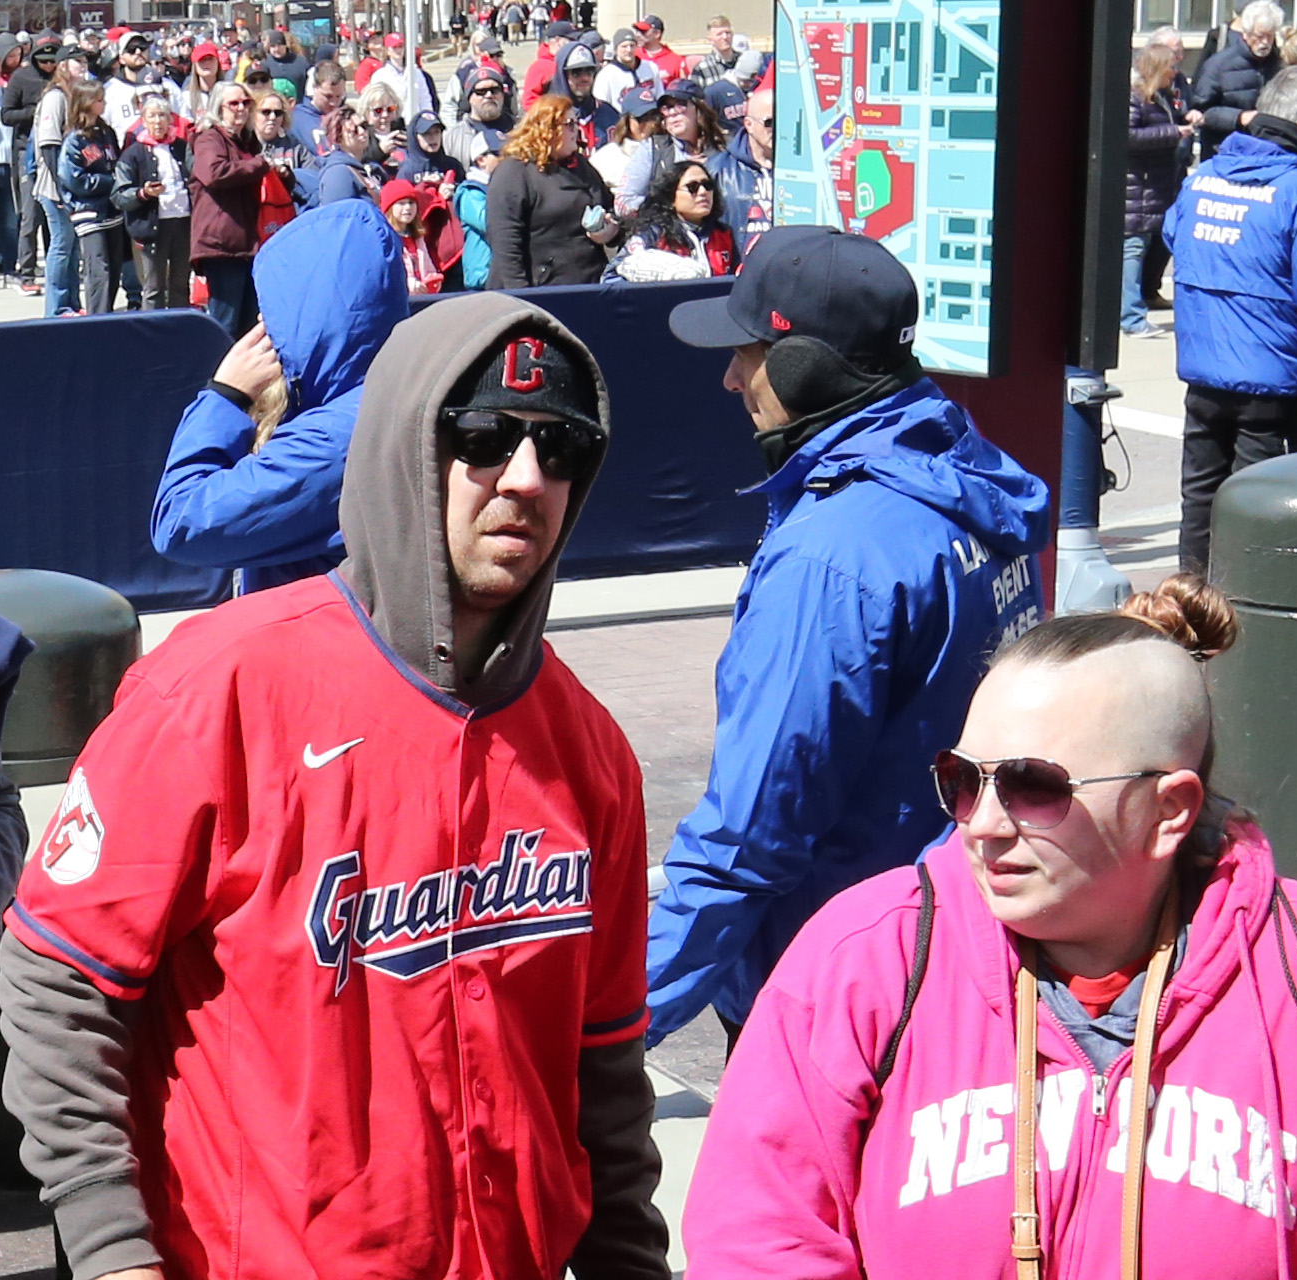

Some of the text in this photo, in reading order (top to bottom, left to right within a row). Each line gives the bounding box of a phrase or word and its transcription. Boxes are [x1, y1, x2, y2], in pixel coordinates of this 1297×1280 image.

[80, 11, 103, 23] WT
[1196, 198, 1248, 222] EVENT
[1193, 221, 1241, 245] STAFF
[501, 336, 547, 393] C
[991, 554, 1031, 615] EVENT
